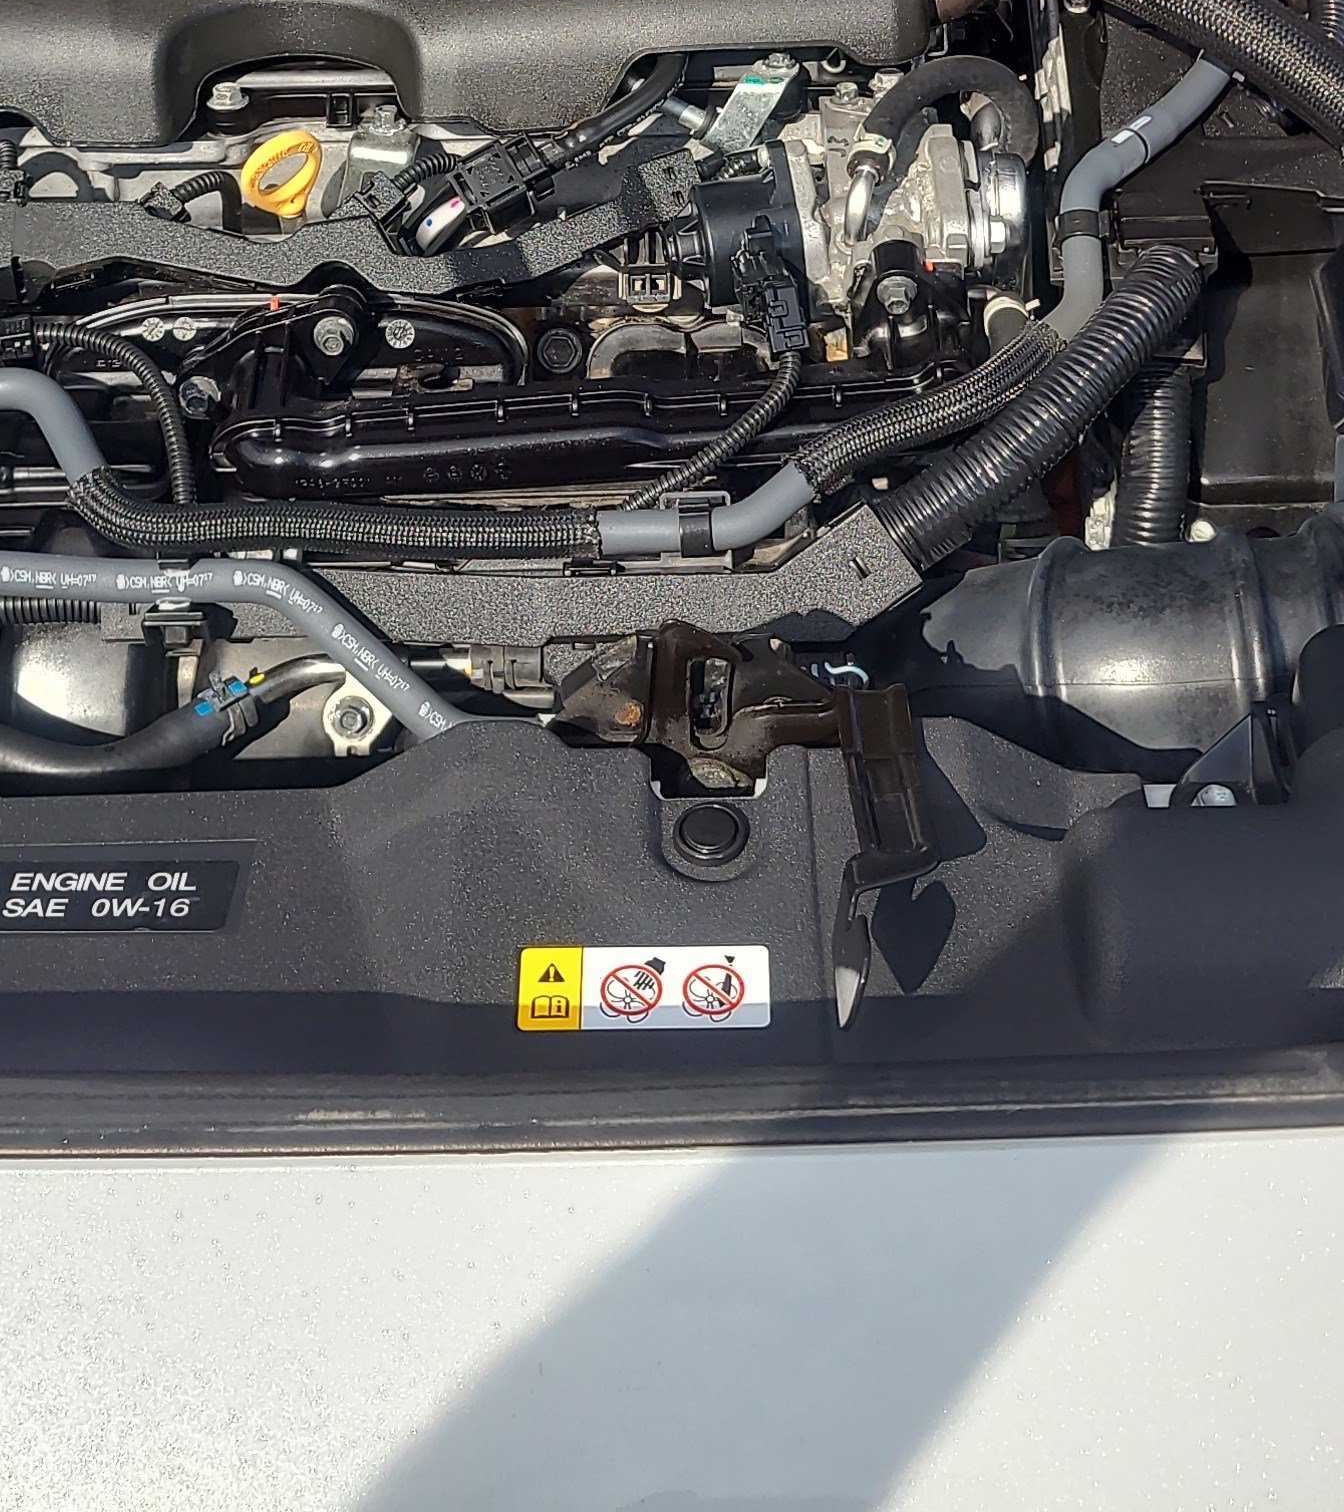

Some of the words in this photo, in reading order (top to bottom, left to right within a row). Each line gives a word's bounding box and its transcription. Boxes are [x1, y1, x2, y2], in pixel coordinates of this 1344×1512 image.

[10, 871, 128, 892] ENGINE
[147, 871, 197, 892] OIL
[2, 897, 69, 918] SAE
[91, 897, 191, 918] 0W-16
